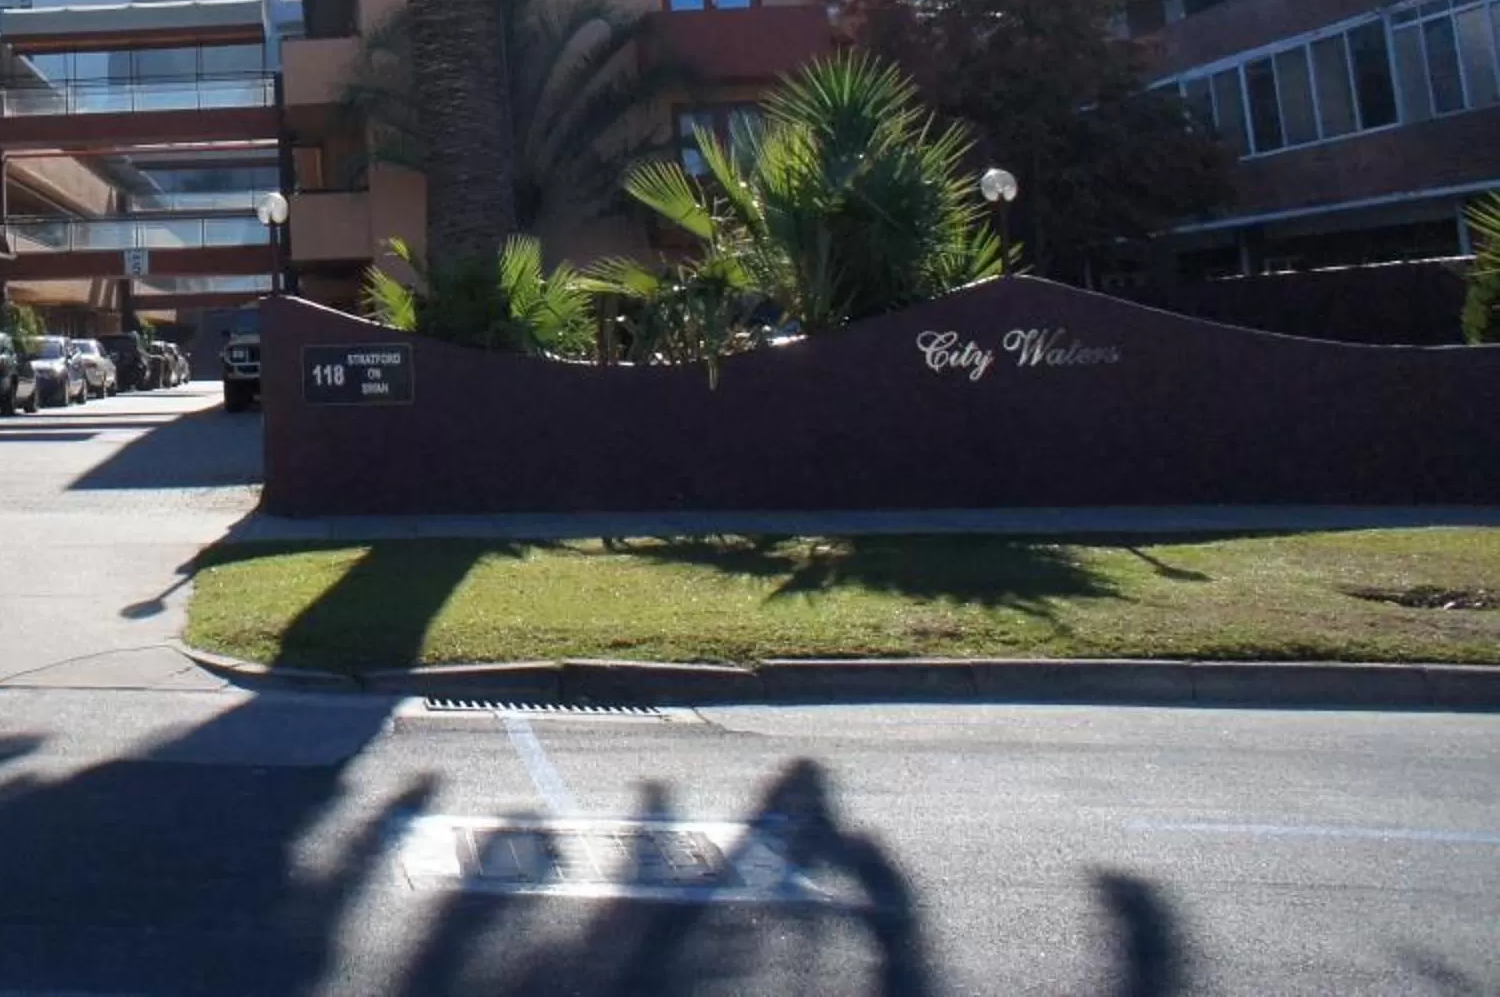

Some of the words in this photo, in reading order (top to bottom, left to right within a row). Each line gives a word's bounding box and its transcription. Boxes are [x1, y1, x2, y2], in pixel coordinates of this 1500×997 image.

[347, 353, 401, 365] STRATFORD
[916, 330, 995, 381] City
[1003, 327, 1120, 368] Waters
[312, 364, 345, 386] 118
